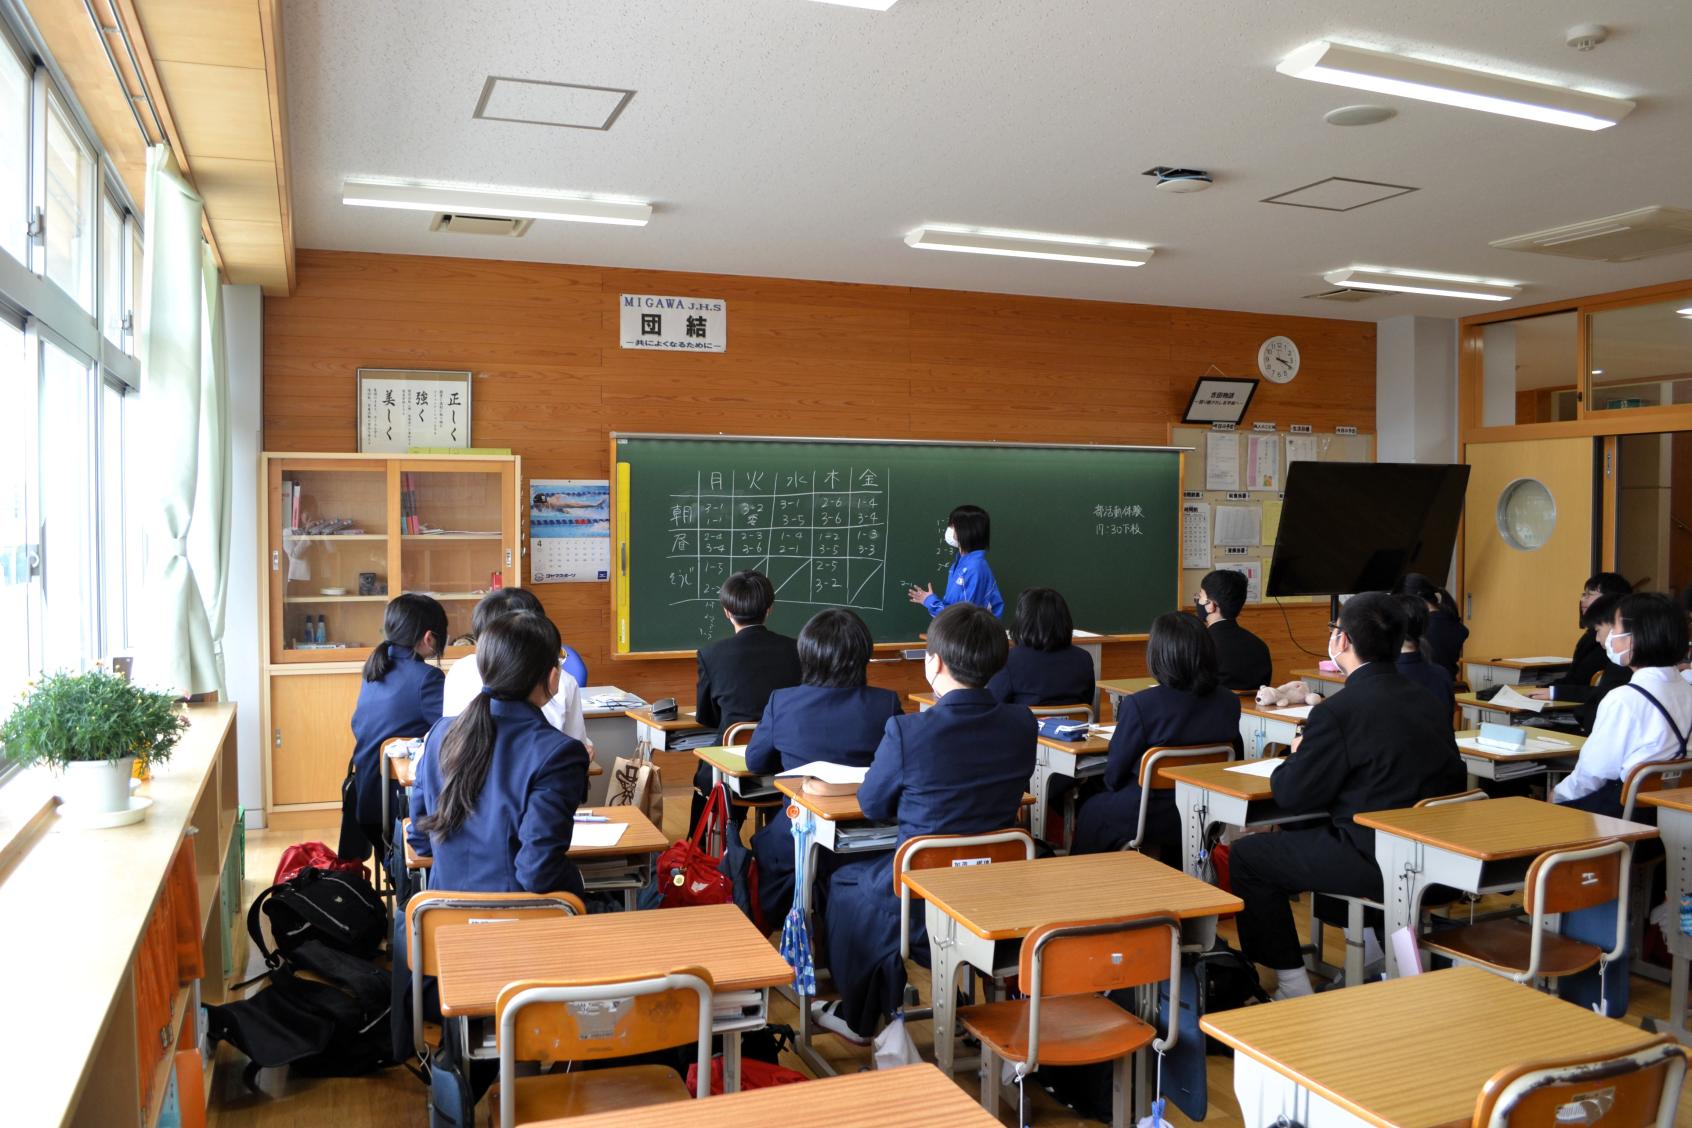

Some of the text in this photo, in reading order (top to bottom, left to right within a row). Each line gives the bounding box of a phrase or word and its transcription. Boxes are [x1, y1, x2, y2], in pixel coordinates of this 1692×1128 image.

[624, 296, 685, 310] MIGAWA
[382, 389, 396, 440] 美しく
[415, 390, 429, 422] 強く
[447, 392, 461, 442] 正しく
[710, 468, 879, 490] 月 火 水 木 金
[670, 504, 692, 527] 朝
[857, 498, 878, 509] 1-4
[669, 566, 695, 588] そうじ
[816, 560, 838, 572] 2-5
